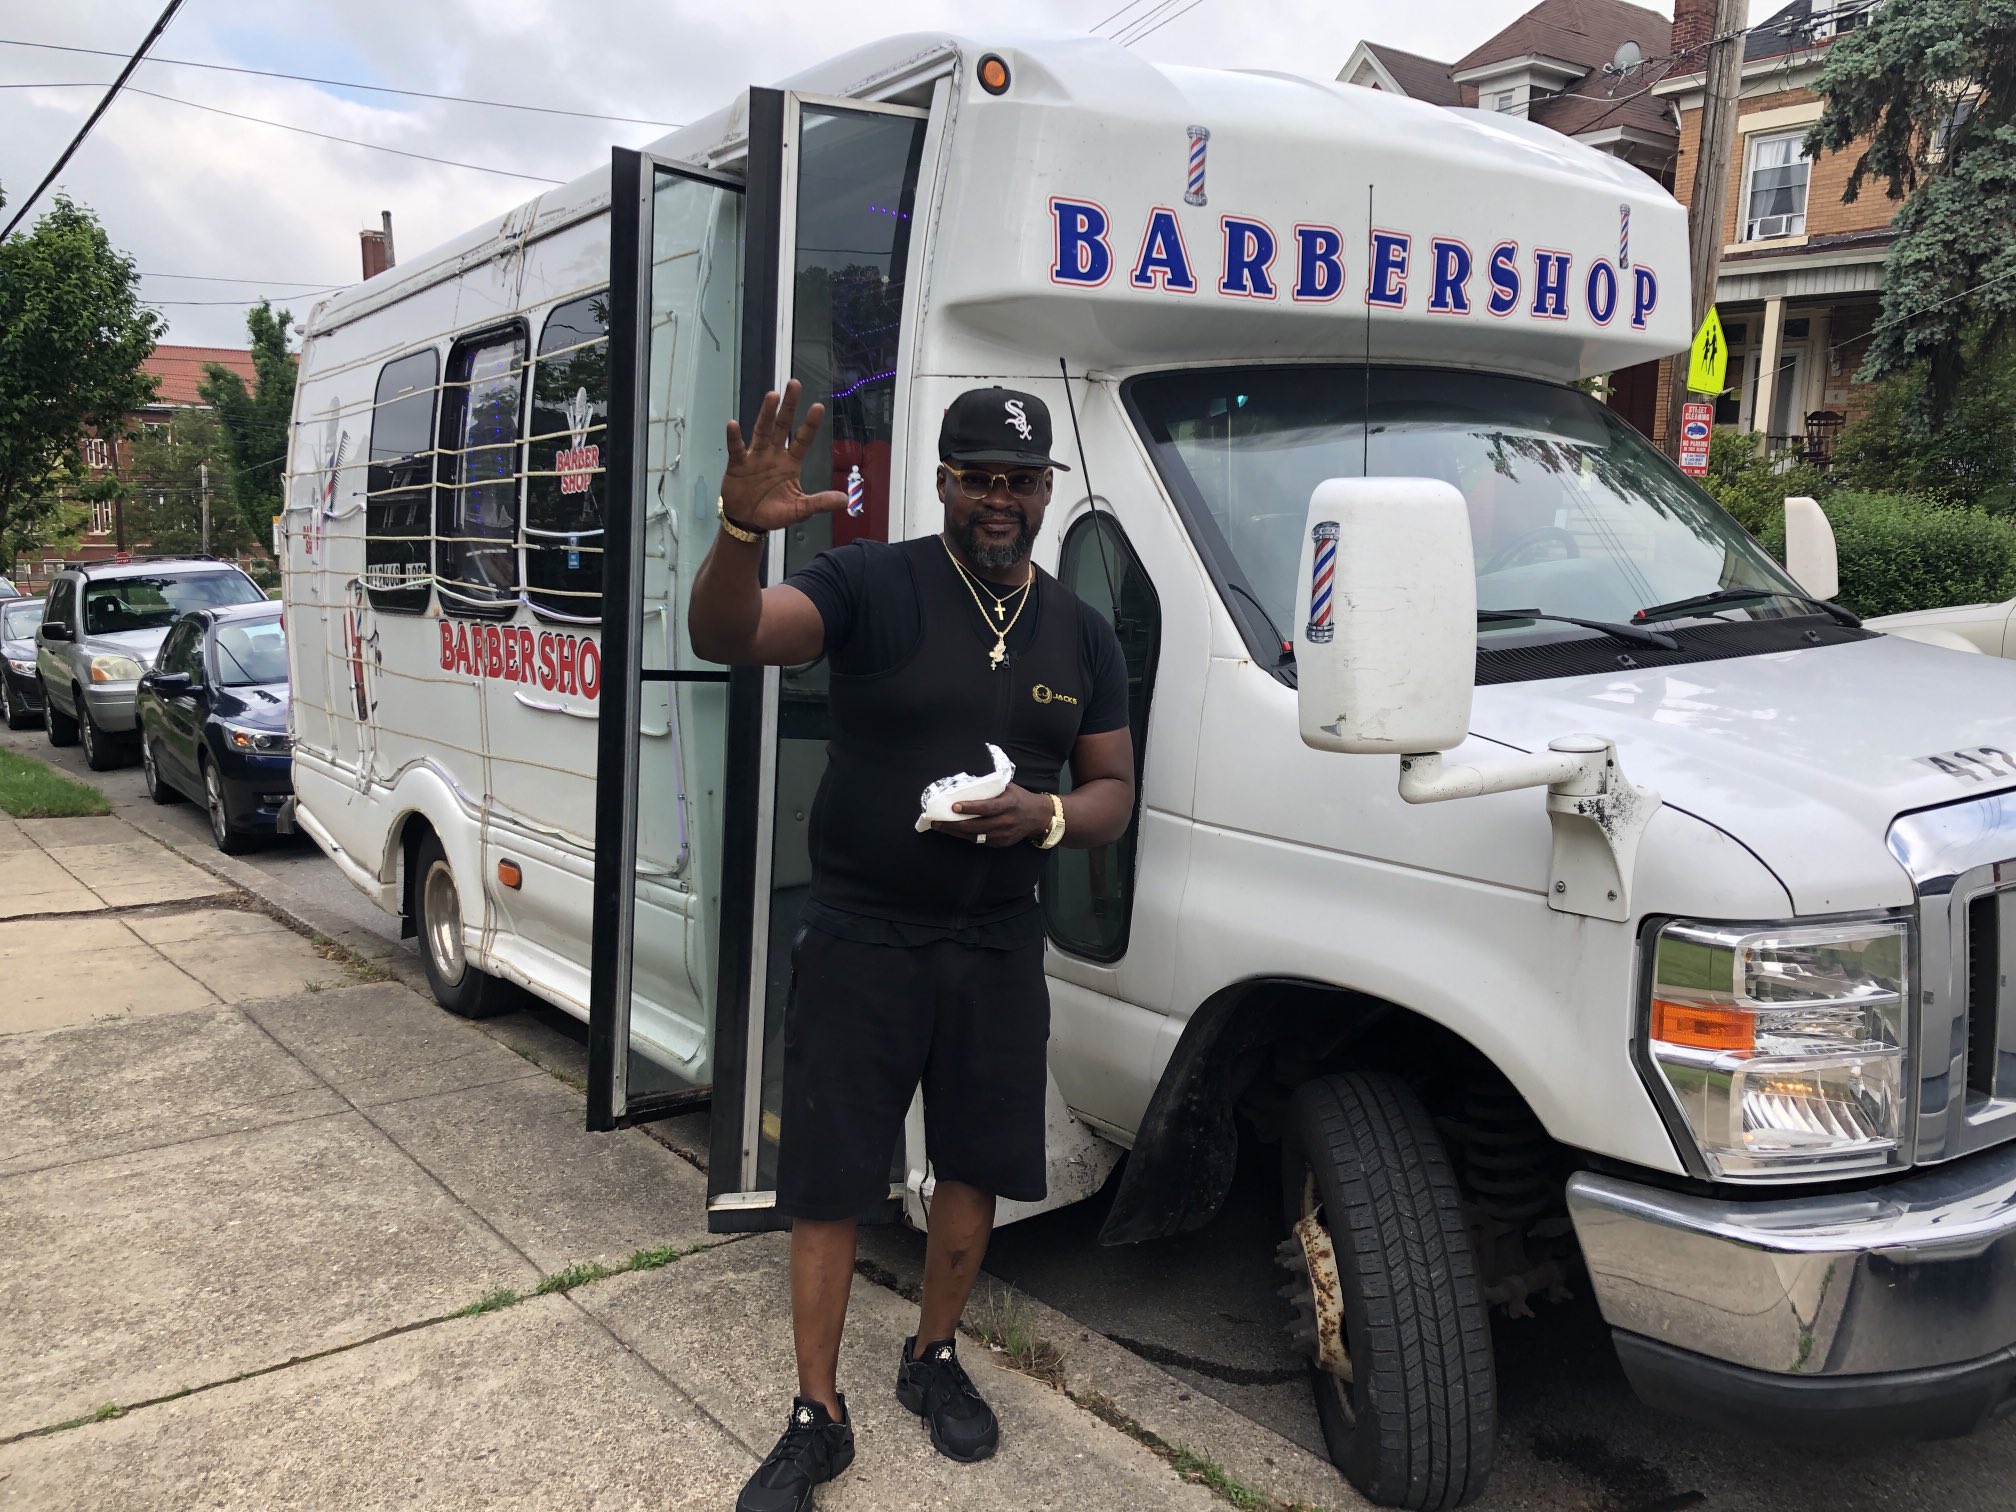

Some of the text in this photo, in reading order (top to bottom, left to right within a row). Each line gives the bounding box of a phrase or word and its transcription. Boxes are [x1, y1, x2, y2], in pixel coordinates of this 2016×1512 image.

[1049, 195, 1658, 330] BARBERSHOP
[1685, 413, 1710, 421] CLEANING
[1689, 406, 1708, 414] STREET
[556, 445, 599, 471] BARBER
[561, 472, 592, 494] SHOP
[439, 619, 601, 700] BARBERSHO
